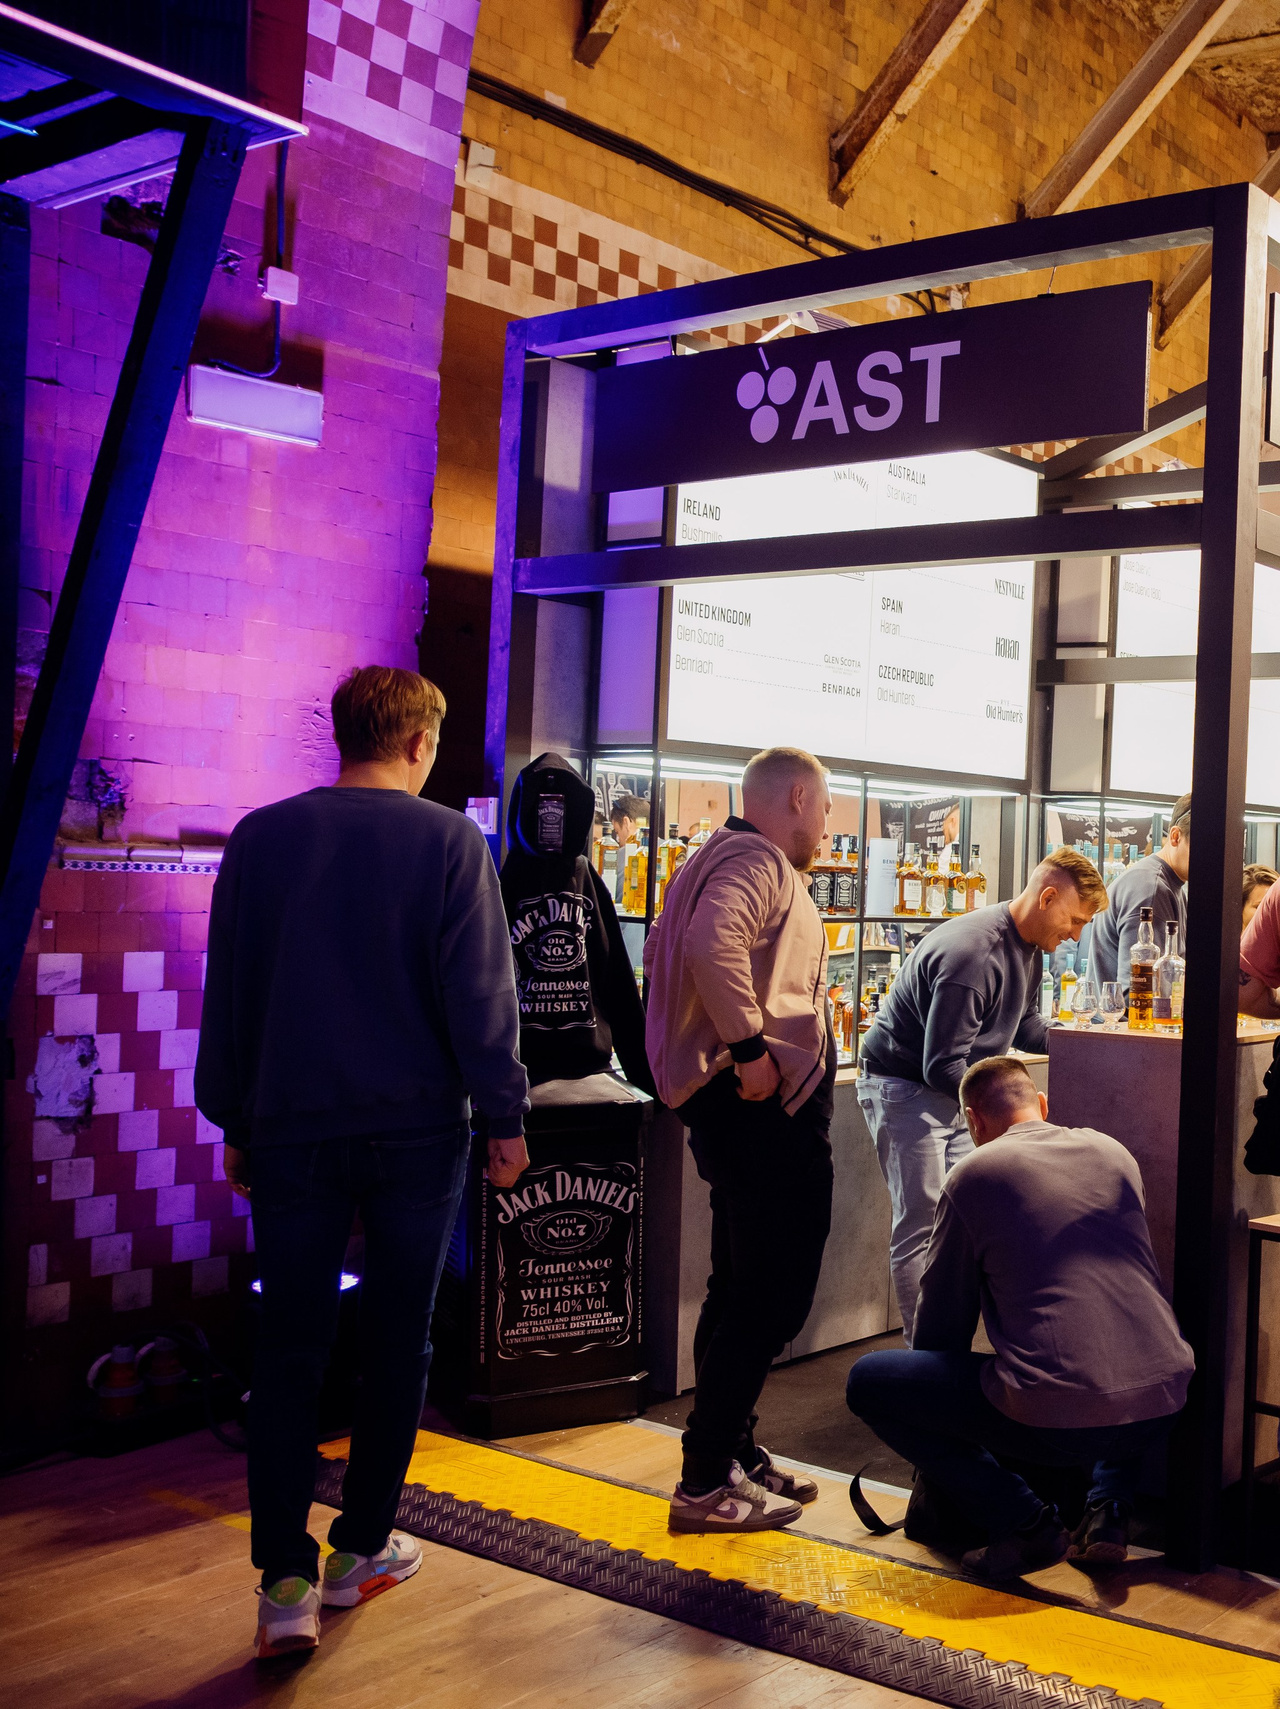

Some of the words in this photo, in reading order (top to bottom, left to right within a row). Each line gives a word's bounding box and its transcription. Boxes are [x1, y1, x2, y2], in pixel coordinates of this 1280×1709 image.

[791, 340, 961, 441] AST
[888, 463, 926, 486] AUSTRALIA
[683, 498, 721, 521] IRELAND
[994, 578, 1025, 600] NESTVILLE
[678, 599, 710, 619] UNITED
[711, 605, 751, 627] KINGDOM
[881, 597, 904, 614] SPAIN
[677, 625, 696, 642] Glen
[697, 628, 724, 648] Scotia
[880, 619, 901, 636] Haran
[675, 654, 713, 675] Benriach
[823, 654, 839, 665] GLEN
[840, 657, 861, 668] SCOTIA
[878, 665, 901, 681] CZECH
[902, 669, 934, 687] REPUBLIC
[822, 682, 861, 697] BENRIACH
[877, 687, 888, 702] Old
[888, 689, 915, 706] Hunters
[986, 704, 996, 719] Old
[548, 937, 565, 945] Old
[522, 976, 589, 992] Tennessee
[520, 1001, 589, 1013] WHISKEY
[495, 1181, 553, 1224] JACK
[555, 1171, 639, 1214] DANIEL'S
[556, 1217, 577, 1225] Old
[519, 1257, 613, 1278] Tennessee
[520, 1280, 611, 1301] WHISKEY
[522, 1302, 549, 1318] 75cl
[553, 1299, 582, 1314] 40%
[586, 1296, 609, 1310] Vol.
[504, 1327, 529, 1337] JACK
[531, 1322, 567, 1333] DANIEL
[569, 1316, 625, 1329] DISTILLERY
[516, 1318, 553, 1328] DISTILLED
[554, 1316, 569, 1324] AND
[571, 1312, 602, 1322] BOTTLED
[548, 1330, 585, 1340] TENNESSEE
